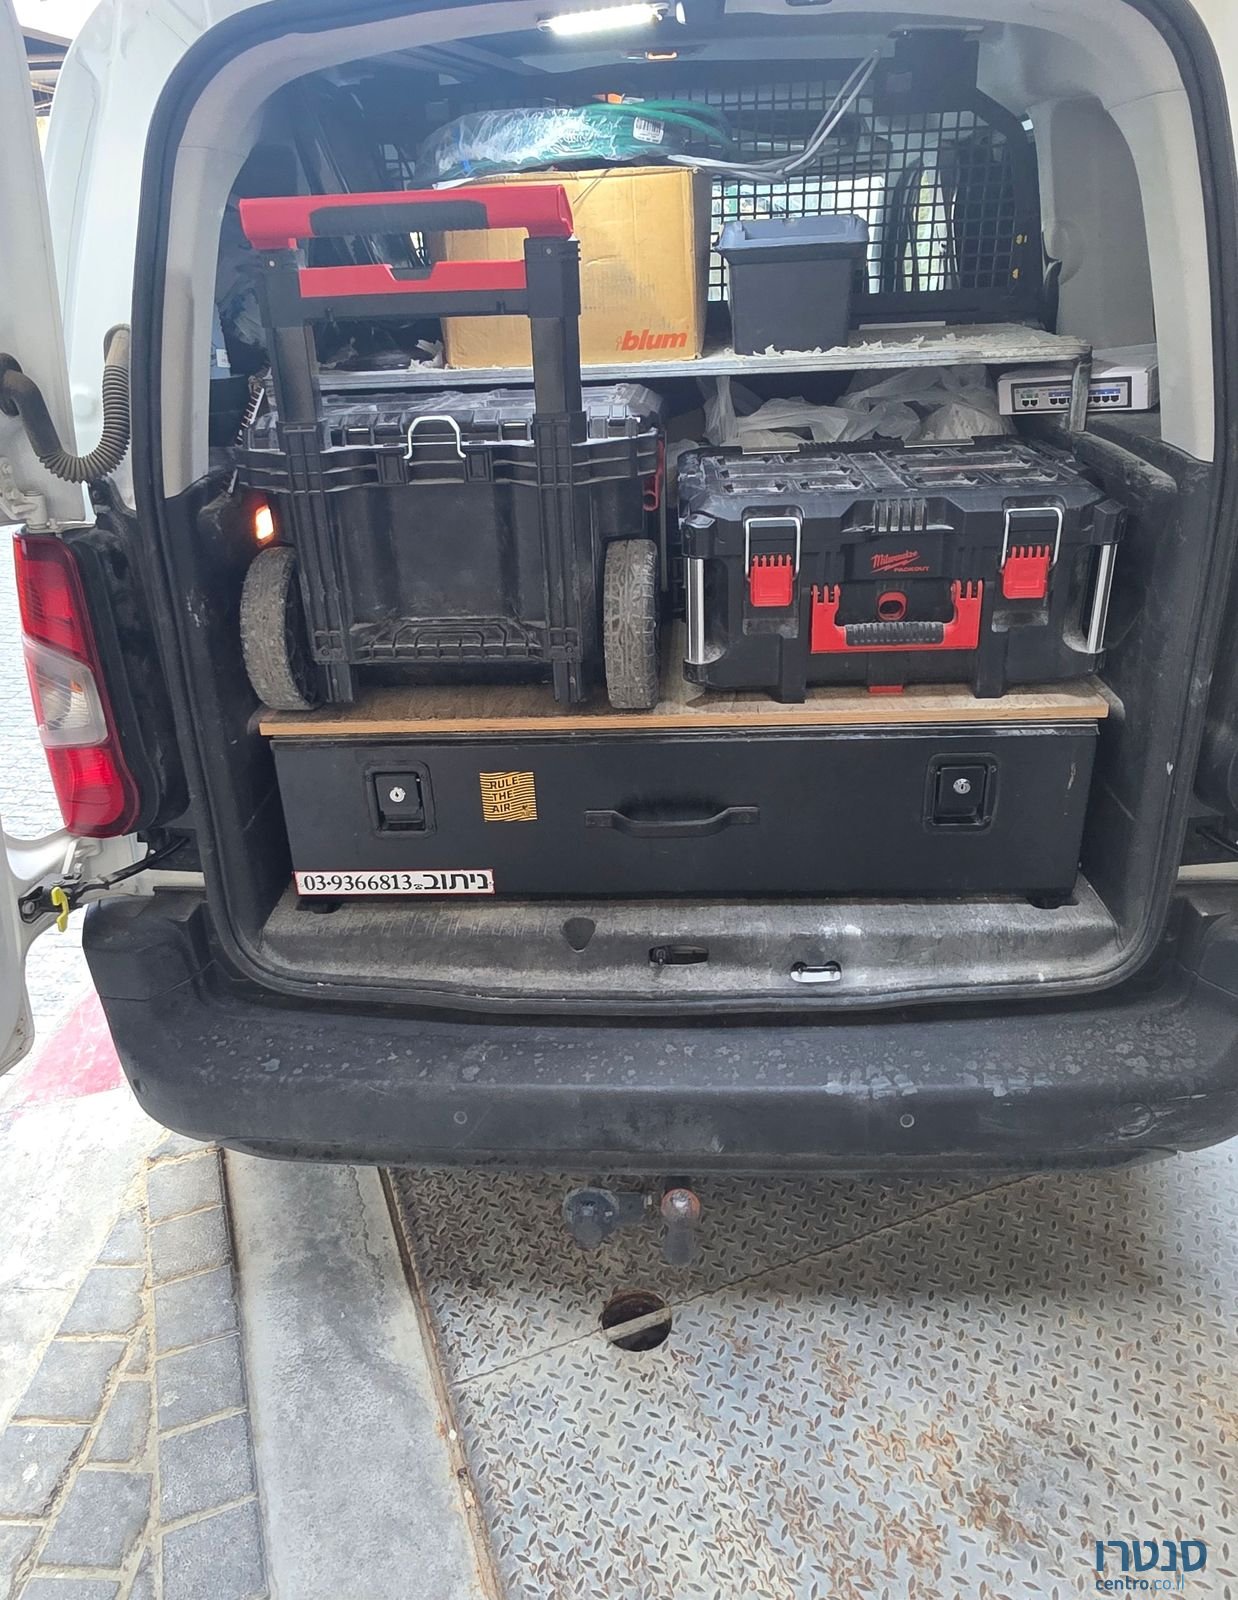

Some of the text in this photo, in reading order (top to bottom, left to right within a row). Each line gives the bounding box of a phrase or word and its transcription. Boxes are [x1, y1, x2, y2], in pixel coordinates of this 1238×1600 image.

[621, 328, 687, 351] blum
[490, 776, 519, 789] RULE
[492, 790, 513, 801] THE
[493, 803, 511, 813] AIR
[422, 873, 489, 890] ניתוב
